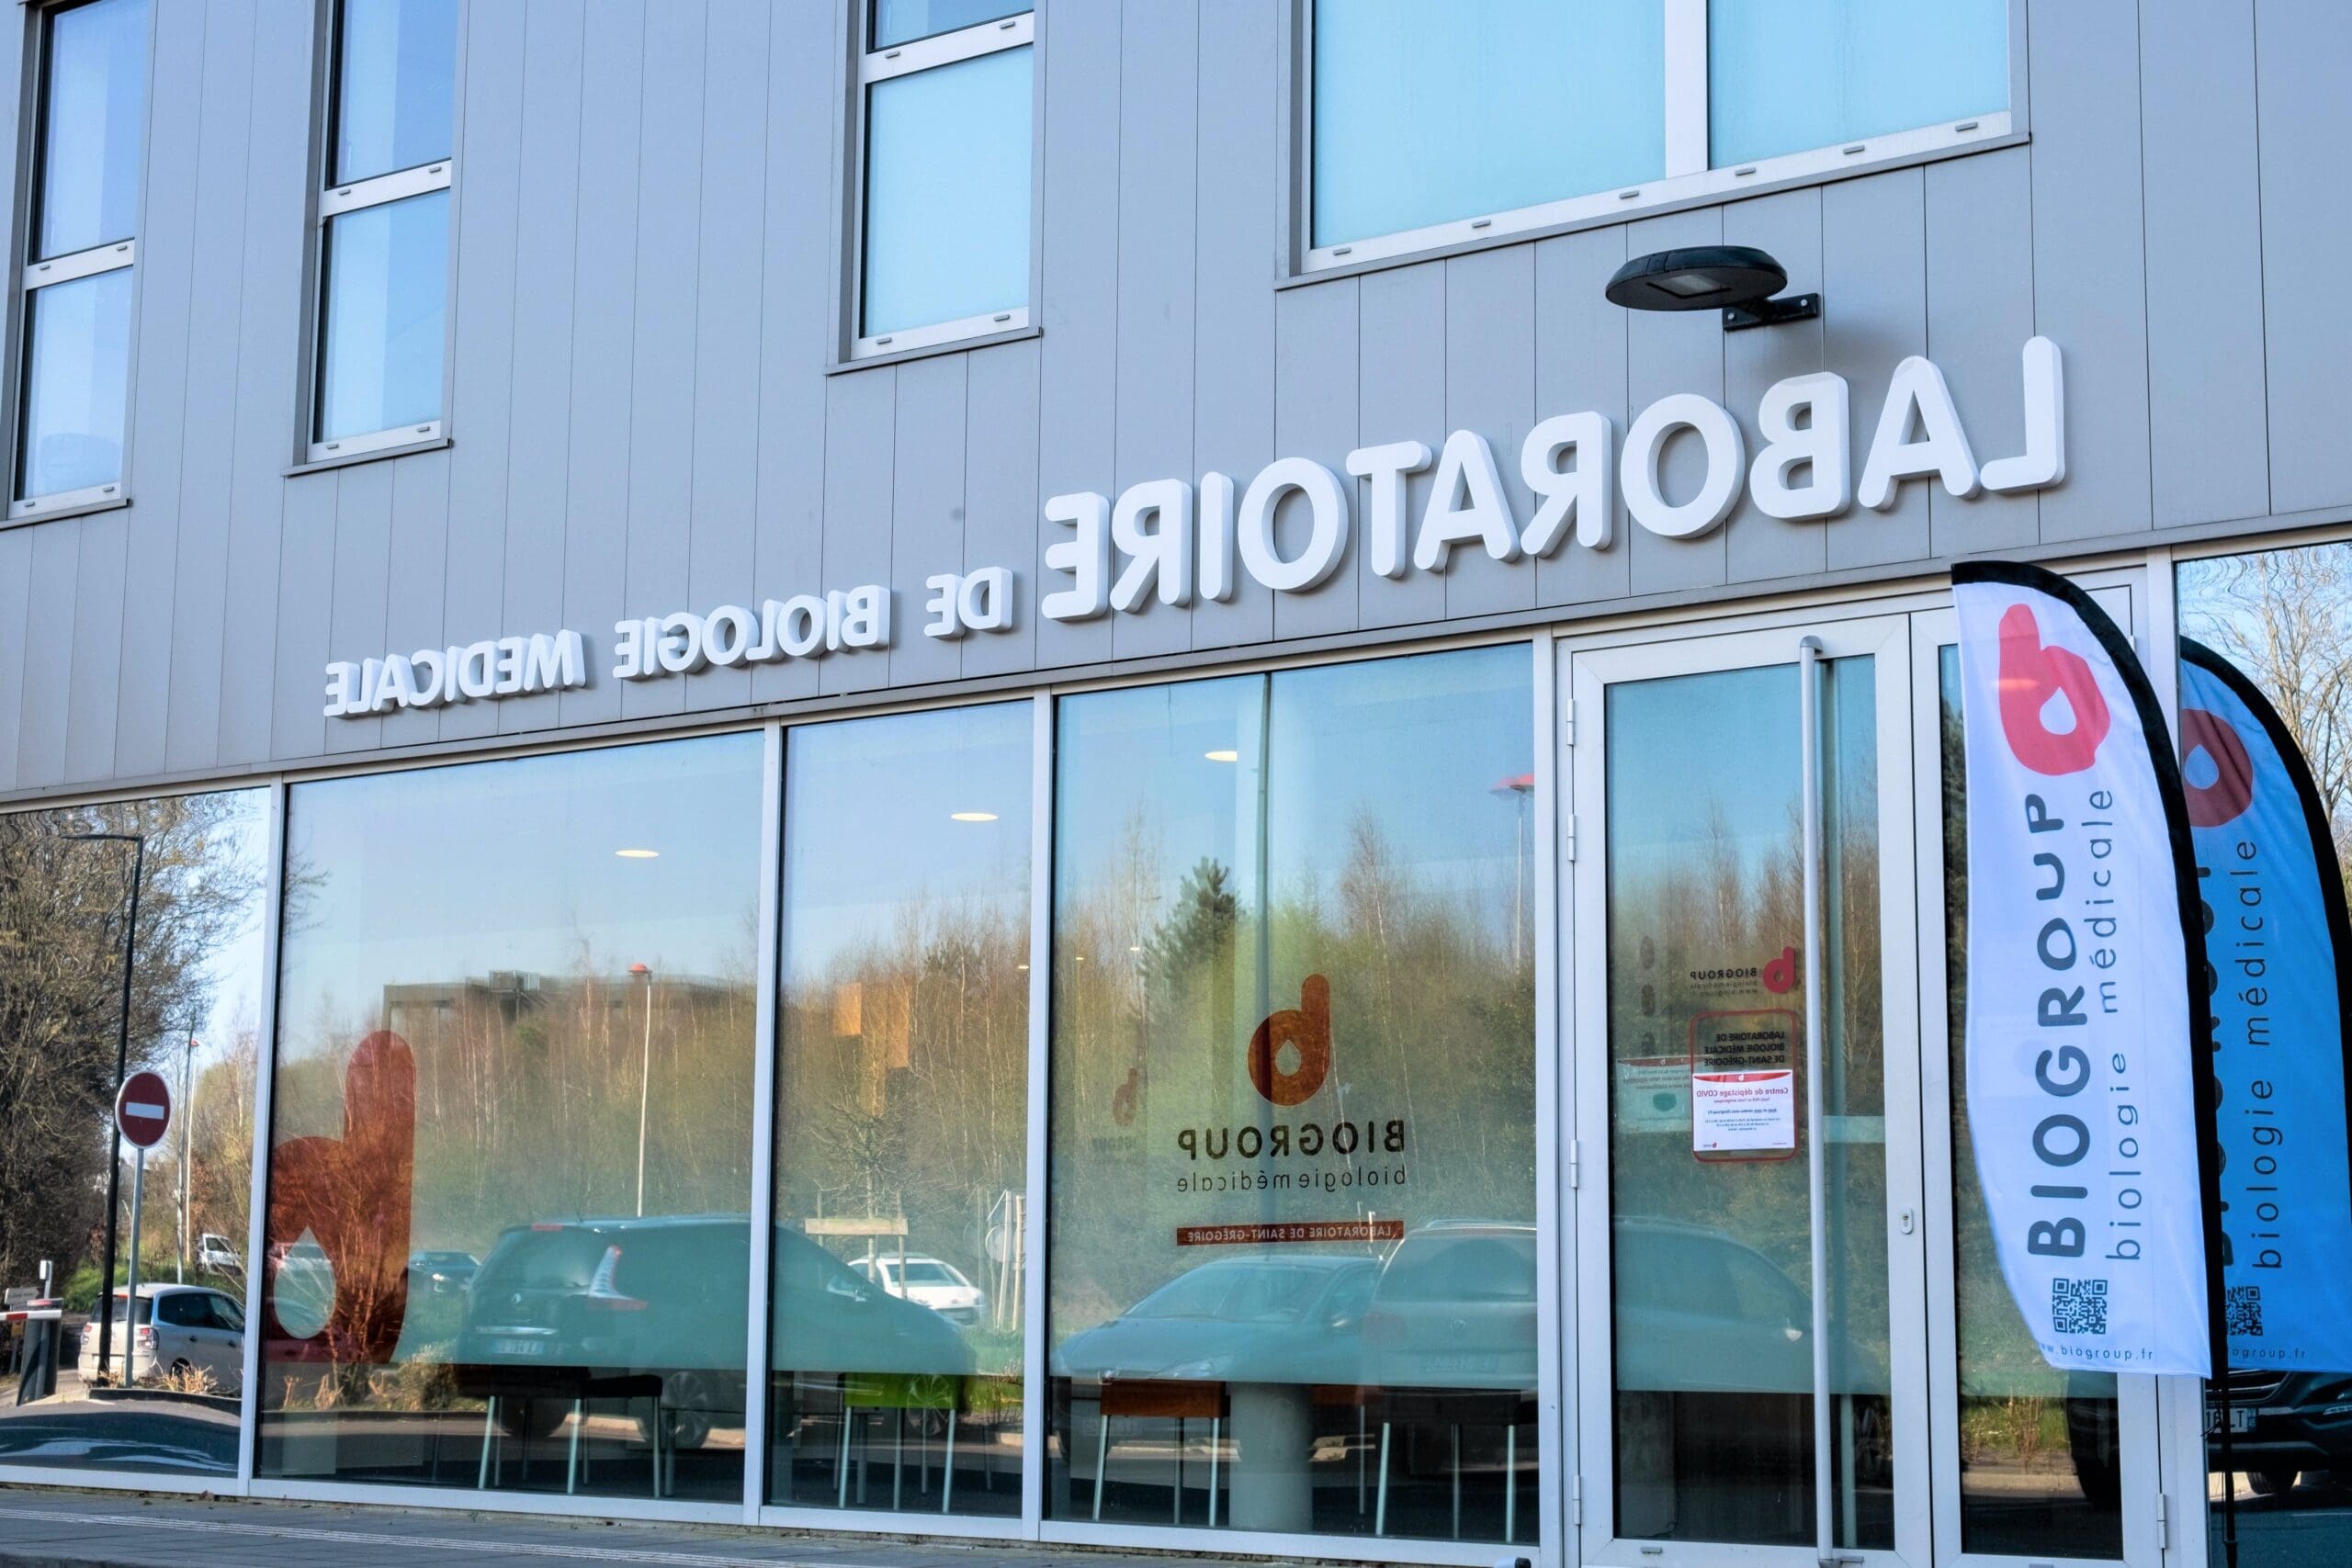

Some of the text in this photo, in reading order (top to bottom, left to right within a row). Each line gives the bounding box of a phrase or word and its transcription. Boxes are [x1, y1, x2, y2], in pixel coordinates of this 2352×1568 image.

[2025, 793, 2091, 1258] BIOGROUP
[2081, 789, 2143, 1260] biologie médicale
[2230, 840, 2283, 1269] biologie médicale
